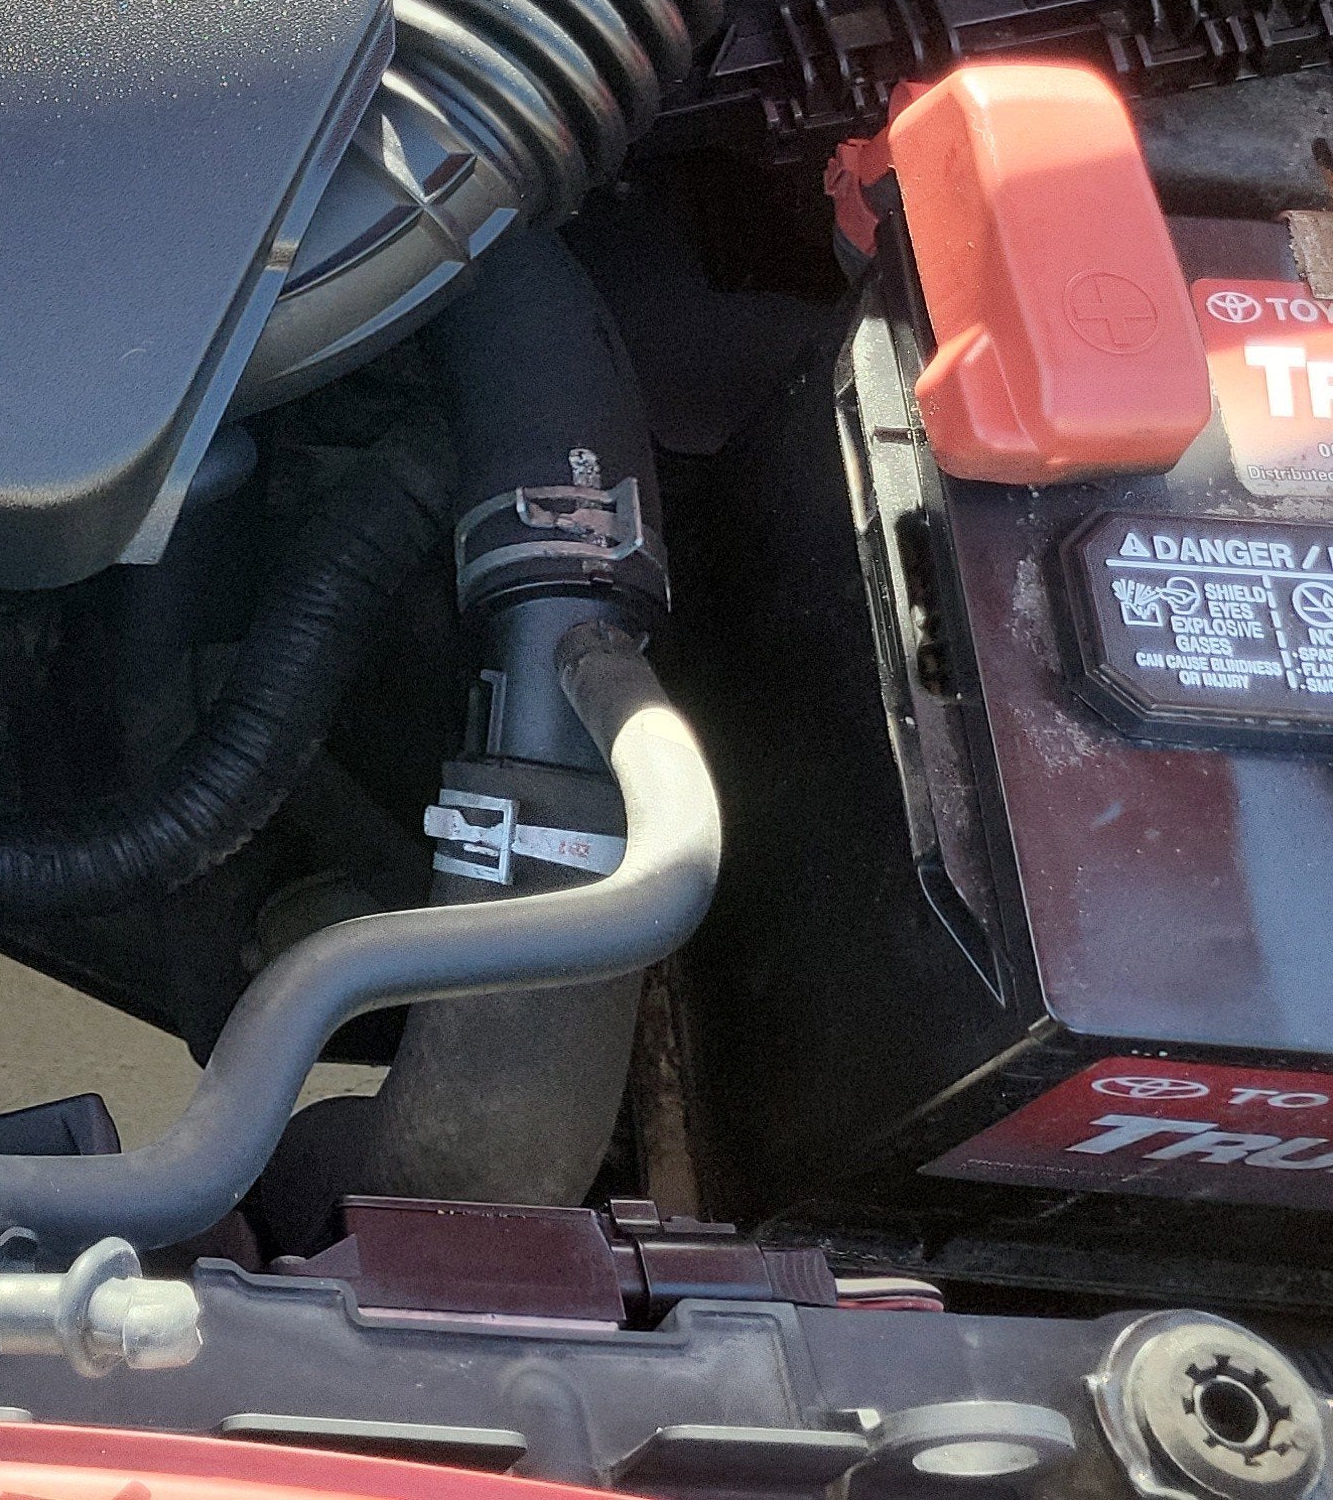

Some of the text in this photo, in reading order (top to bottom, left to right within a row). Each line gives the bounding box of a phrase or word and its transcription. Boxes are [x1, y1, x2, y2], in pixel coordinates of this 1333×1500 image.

[1152, 535, 1295, 569] DANGER
[1204, 582, 1267, 603] SHIELD
[1208, 600, 1254, 620] EYES
[1170, 615, 1265, 639] EXPLOSIVE
[1175, 635, 1233, 655] GASES
[1135, 651, 1283, 676] CAN CAUSE BLINDNESS
[1179, 670, 1249, 690] OR INJURY
